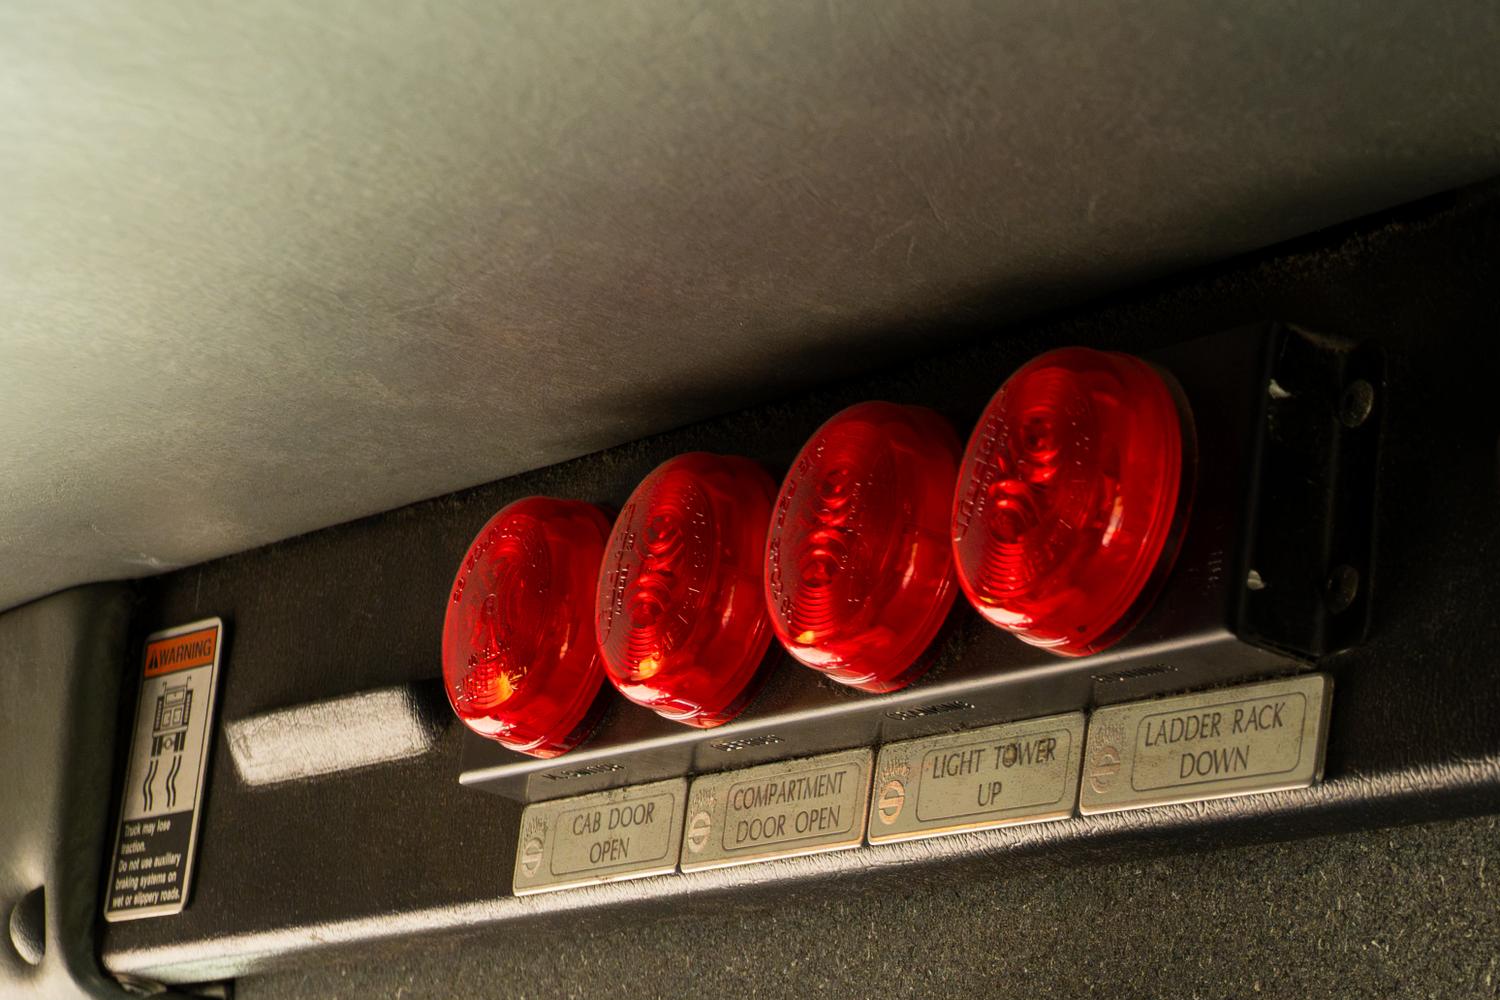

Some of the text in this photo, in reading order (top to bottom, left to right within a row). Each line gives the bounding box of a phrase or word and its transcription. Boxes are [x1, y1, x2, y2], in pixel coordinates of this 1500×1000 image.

[159, 639, 212, 665] WARNING
[1144, 702, 1286, 748] LADDER RACK
[931, 737, 1058, 780] LIGHT TOWER
[1179, 746, 1251, 780] DOWN
[732, 770, 848, 812] COMPARTMENT
[977, 781, 1003, 808] UP
[572, 801, 656, 836] CAB DOOR
[735, 804, 842, 844] DOOR OPEN
[589, 837, 630, 864] OPEN
